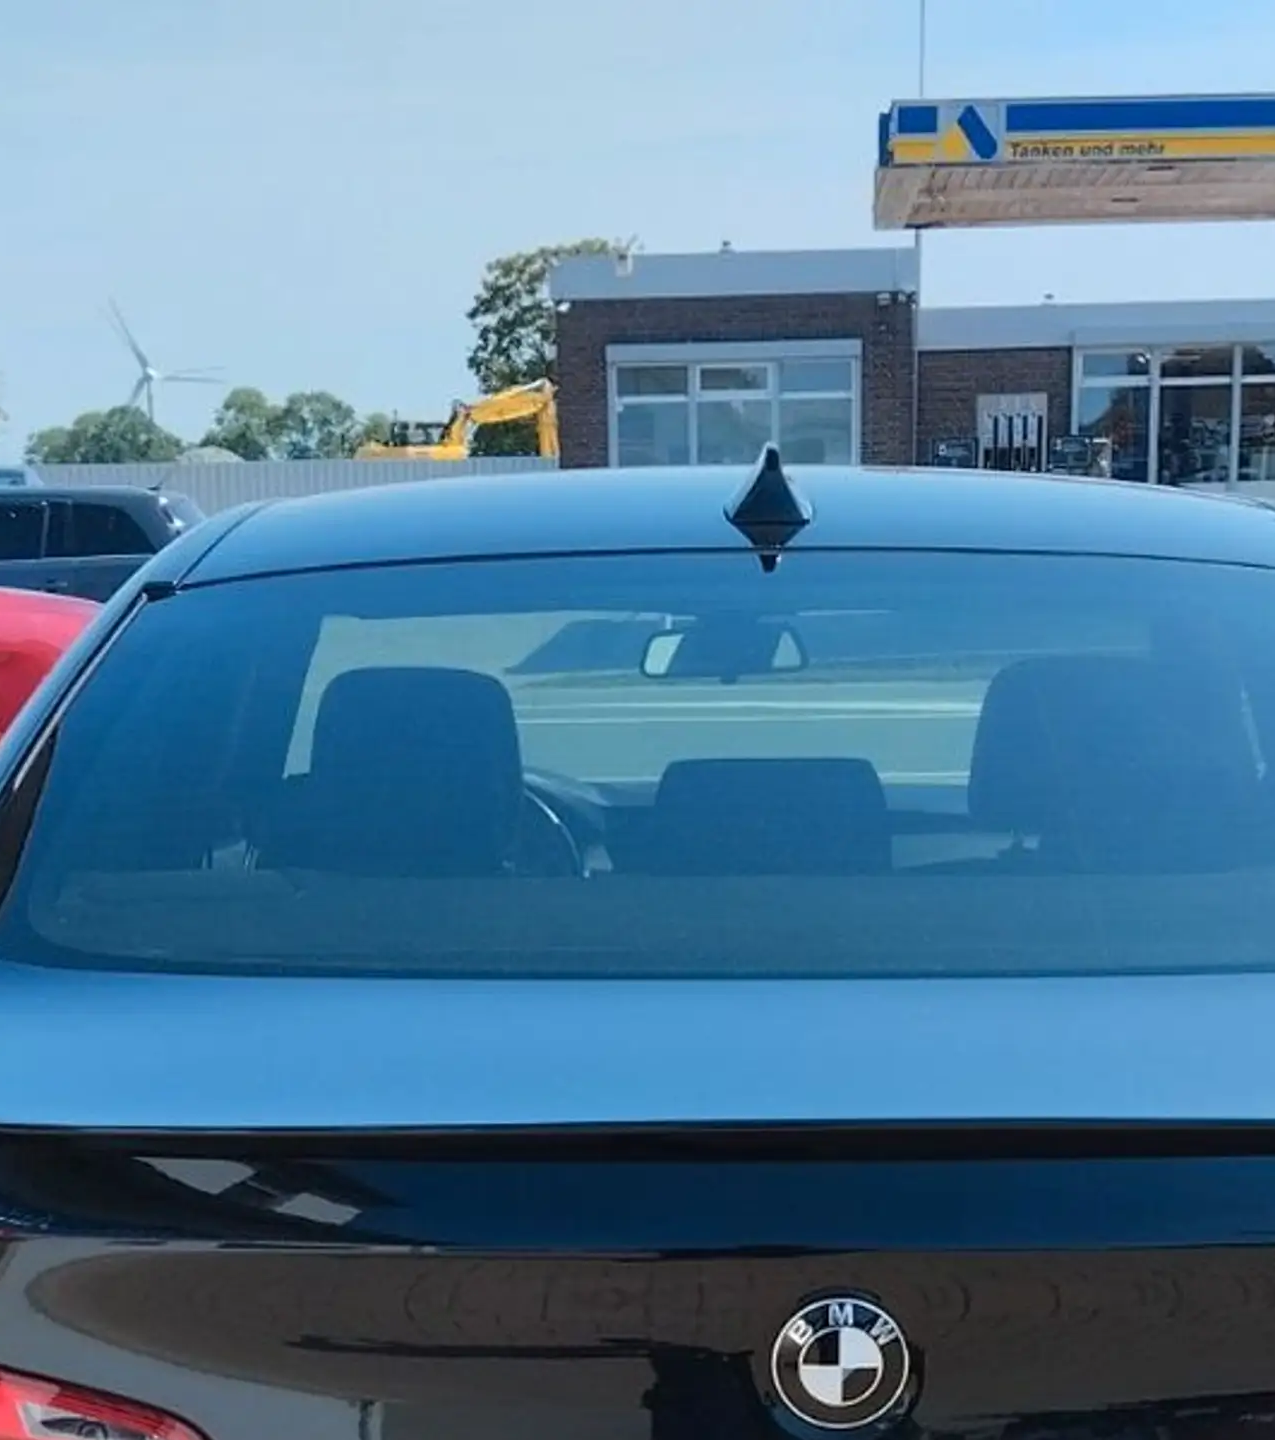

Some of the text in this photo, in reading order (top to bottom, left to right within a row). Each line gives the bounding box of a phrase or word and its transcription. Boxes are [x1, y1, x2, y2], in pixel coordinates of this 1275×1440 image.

[1010, 140, 1166, 158] Tanken und mehr
[786, 1302, 898, 1346] BMW
